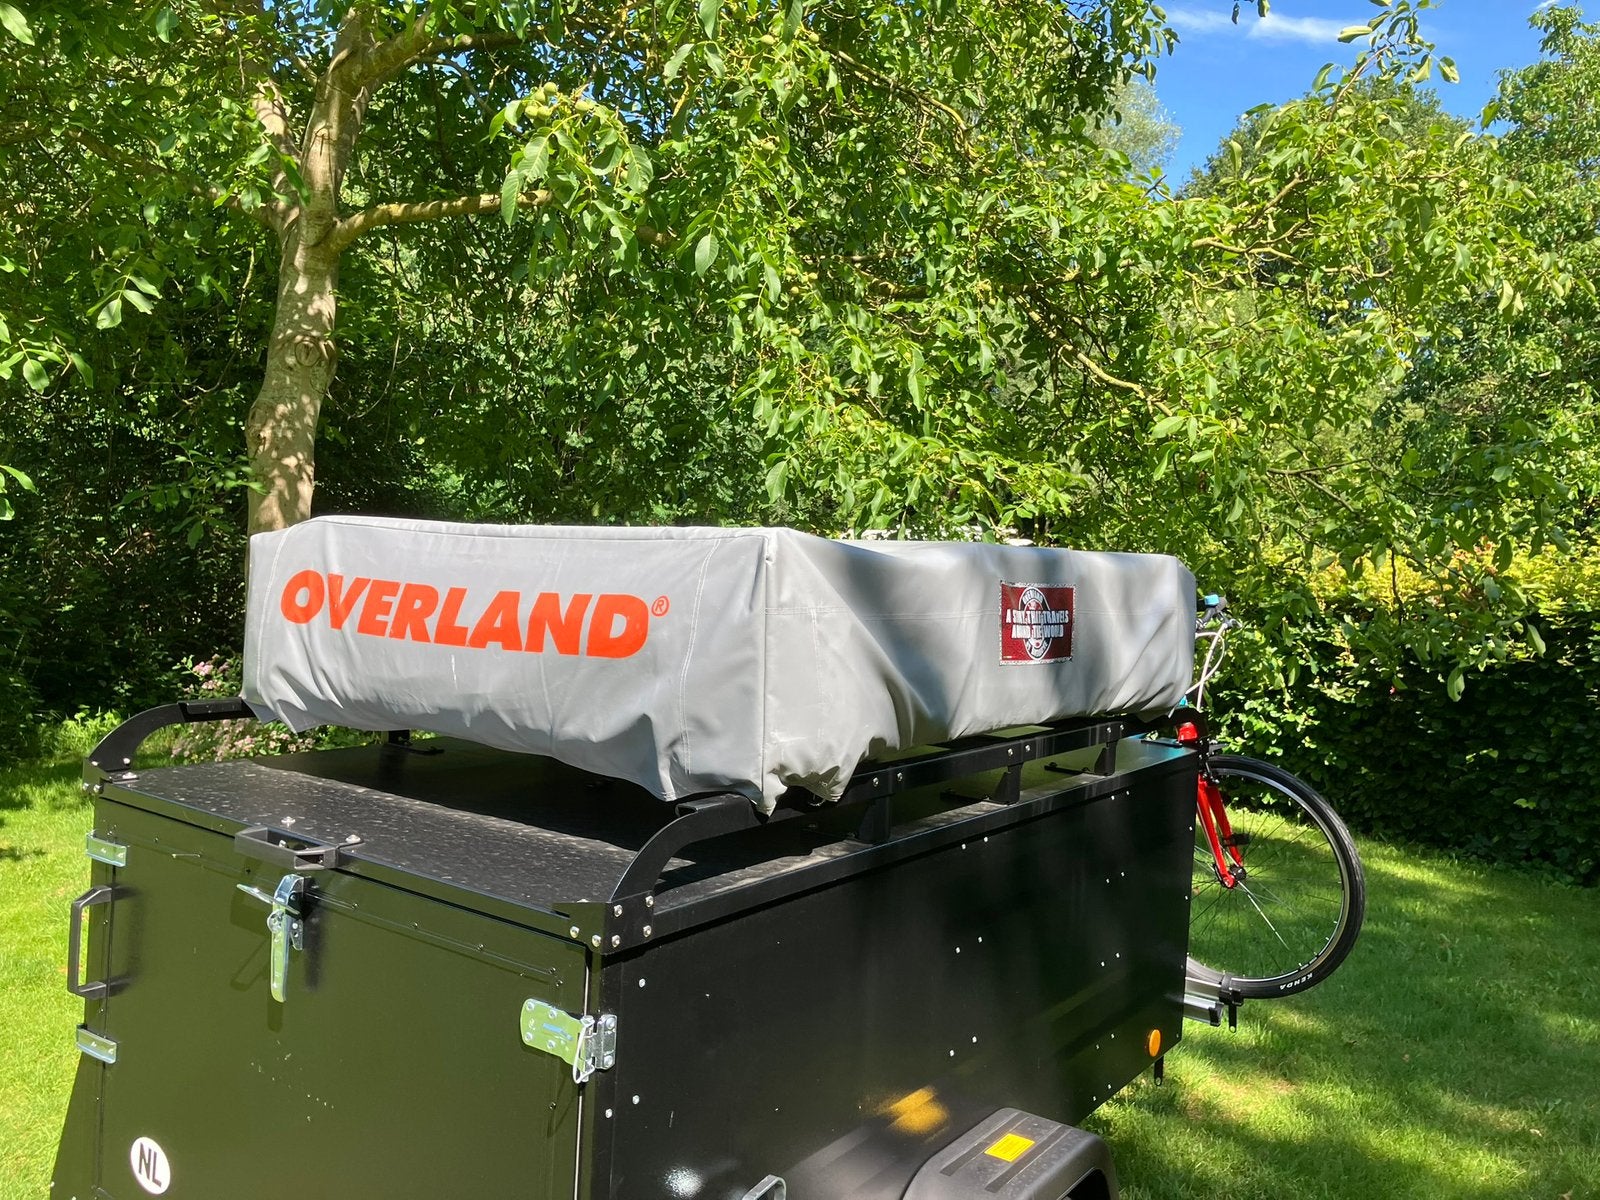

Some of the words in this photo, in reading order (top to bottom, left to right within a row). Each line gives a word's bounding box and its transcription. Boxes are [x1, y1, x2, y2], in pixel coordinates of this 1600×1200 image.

[1005, 609, 1012, 624] A
[1042, 610, 1069, 624] TRAVELS
[1279, 973, 1313, 990] KENDA
[138, 1142, 162, 1188] NL
